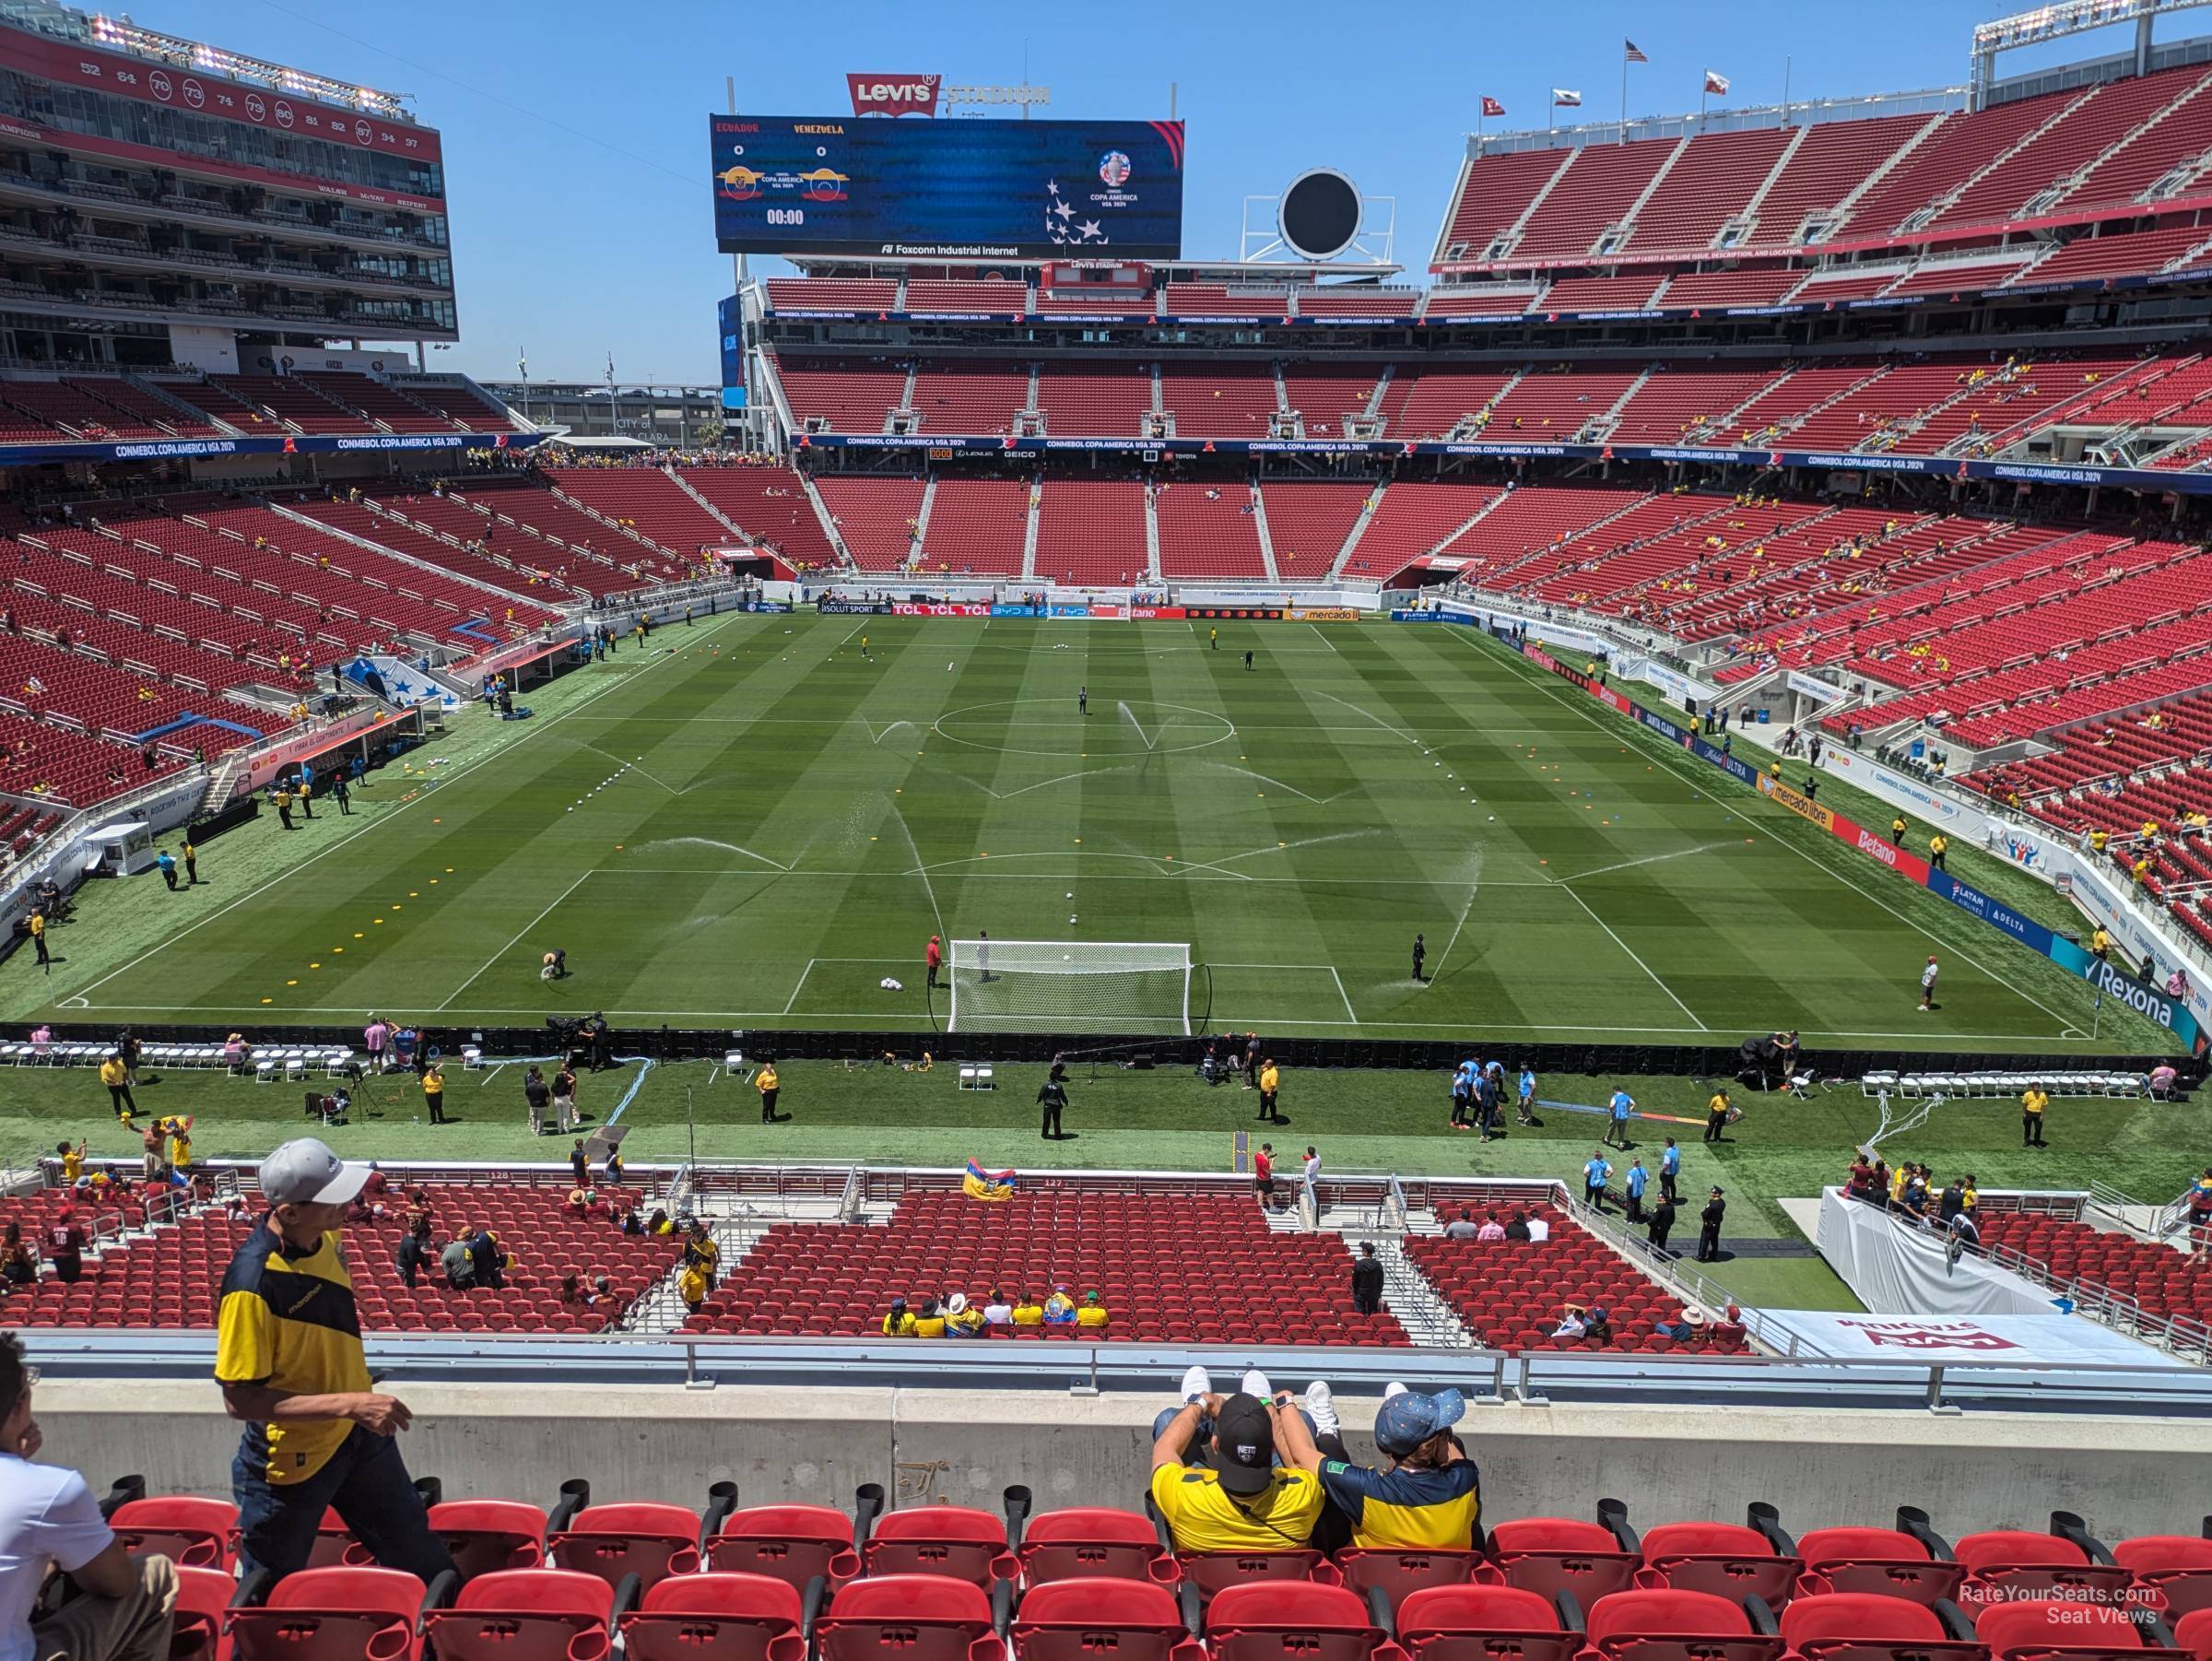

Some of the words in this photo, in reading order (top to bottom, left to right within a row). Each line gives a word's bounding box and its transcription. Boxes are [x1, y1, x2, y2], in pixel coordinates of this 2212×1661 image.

[947, 86, 1051, 105] STADIUM
[80, 62, 101, 77] 52
[184, 87, 204, 100] 73
[217, 94, 234, 107] 74
[305, 115, 319, 126] 81
[331, 121, 347, 133] 82
[405, 137, 418, 148] 97
[716, 123, 759, 133] ECUADOR
[794, 124, 844, 135] VENEZUELA
[318, 185, 347, 196] WALSH
[767, 209, 804, 225] 00:00
[896, 245, 935, 254] Foxconn
[938, 245, 981, 255] Industrial
[982, 246, 1018, 256] Internet
[116, 445, 158, 457] CONMEBOL
[159, 444, 177, 454] COPA
[177, 443, 207, 454] AMERICA
[207, 442, 220, 453] USA
[221, 442, 235, 452] 2024
[337, 439, 380, 448] CONMEBOL
[381, 439, 402, 447] COPA
[402, 438, 431, 447] AMERICA
[432, 437, 446, 446] USA
[446, 437, 462, 445] 2024
[1651, 450, 1677, 458] CONMEBOL
[1677, 450, 1691, 459] COPA
[1691, 451, 1713, 459] AMERICA
[1714, 452, 1725, 460] USA
[1725, 453, 1739, 461] 2024
[1808, 456, 1842, 465] CONMEBOL
[1843, 457, 1861, 466] COPA
[1861, 458, 1890, 467] AMERICA
[1893, 459, 1905, 469] USA
[1907, 461, 1924, 469] 2024
[1995, 465, 2027, 477] CONMEBOL
[2027, 467, 2043, 478] COPA
[2042, 468, 2070, 479] AMERICA
[2072, 470, 2084, 481] USA
[2085, 472, 2101, 482] 2024
[850, 605, 874, 613] SPORT
[893, 605, 923, 615] TCL
[928, 606, 956, 615] TCL
[962, 606, 991, 615] TCL
[992, 607, 1021, 616] BYD
[1646, 713, 1661, 731] SANTA
[1661, 720, 1676, 738] CLARA
[1726, 759, 1747, 778] ULTRA
[1876, 773, 1899, 789] CONMEBOL
[1899, 783, 1911, 795] COPA
[1911, 789, 1931, 804] AMERICA
[150, 798, 177, 816] ROCKING
[1775, 785, 1808, 814] mercado
[1809, 802, 1827, 824] libre
[1857, 830, 1896, 866] Betano
[1959, 887, 1984, 907] LATAM
[1959, 898, 1983, 915] AIRLINES
[2000, 913, 2024, 933] DELTA
[2099, 961, 2171, 1028] Rexona
[2194, 992, 2208, 1012] 2024
[1836, 1320, 1983, 1331] STADIUM
[1238, 1445, 1256, 1455] NETS
